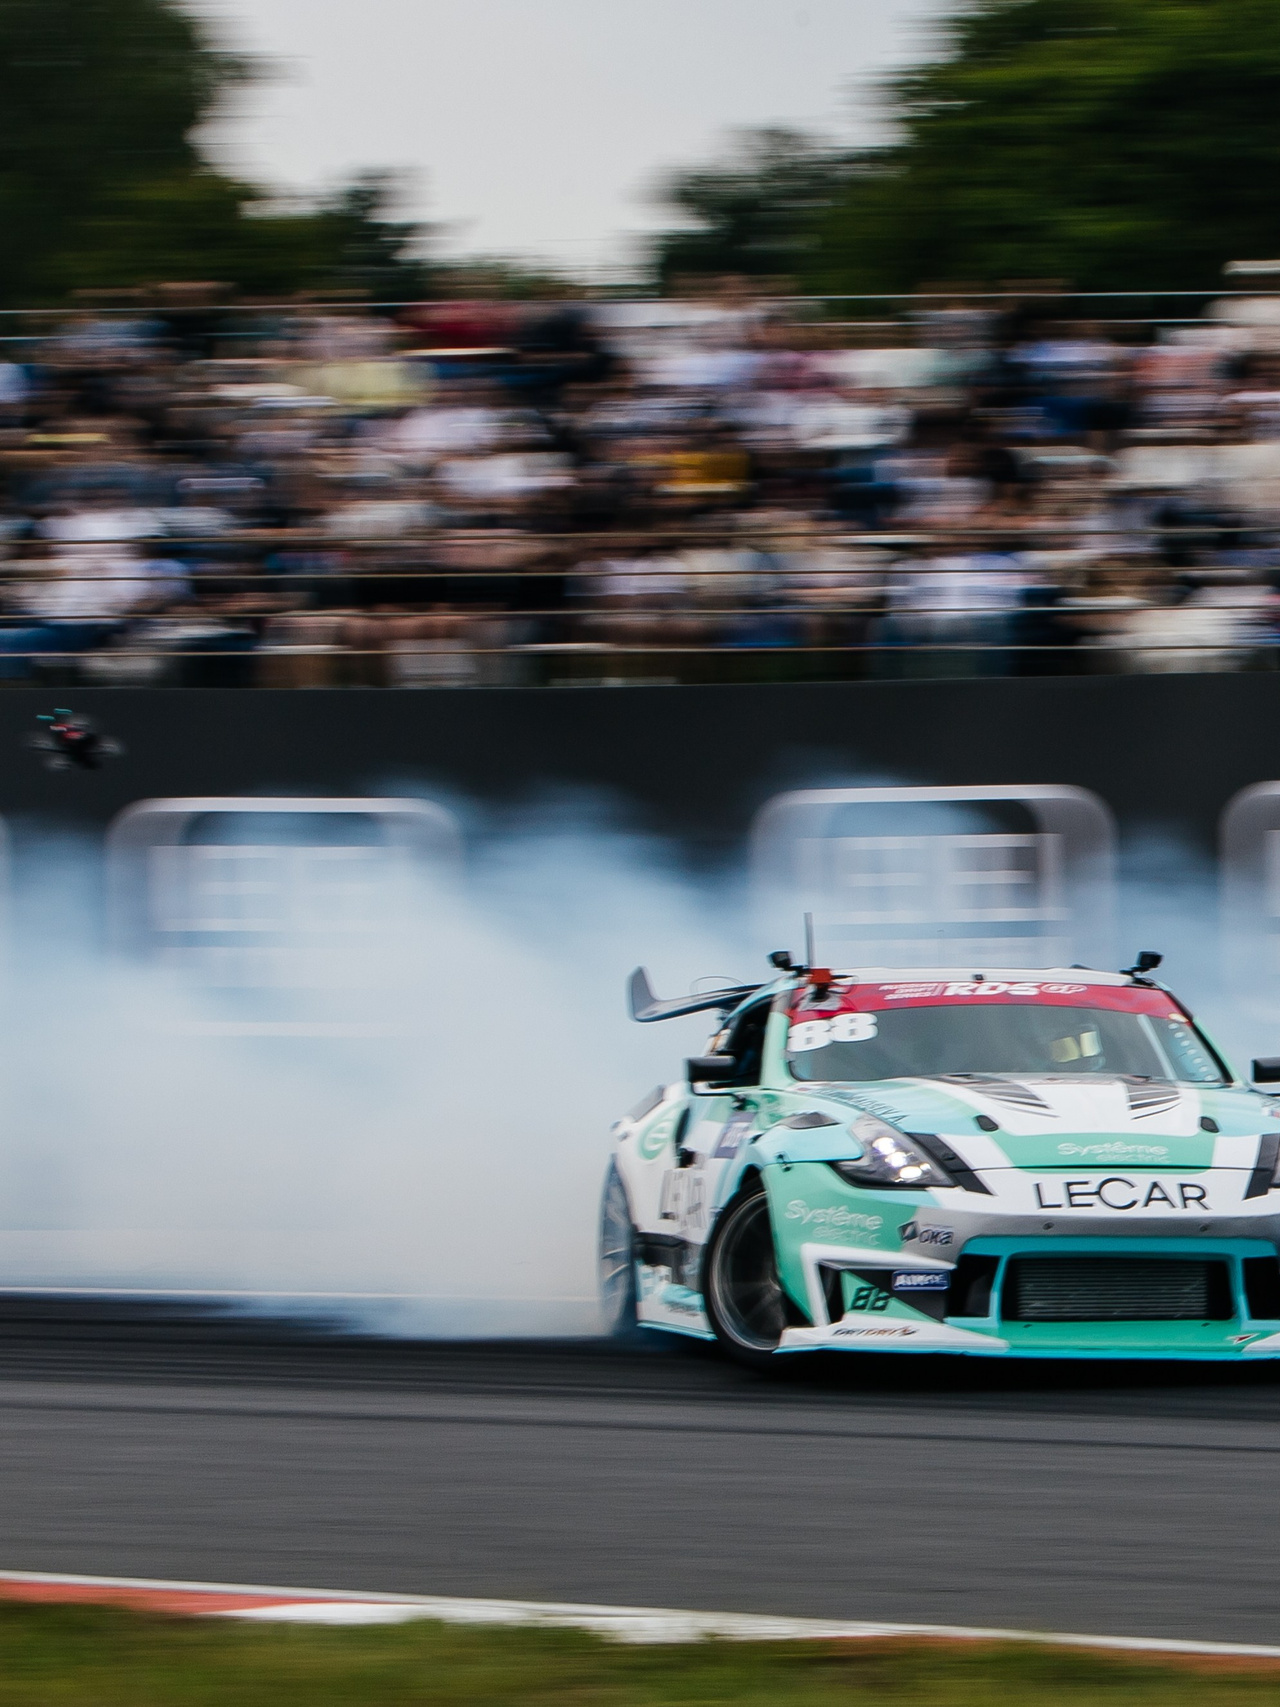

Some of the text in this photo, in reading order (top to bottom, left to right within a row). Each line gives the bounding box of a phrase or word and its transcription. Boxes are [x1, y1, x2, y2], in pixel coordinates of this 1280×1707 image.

[943, 982, 1041, 995] RDS
[787, 1013, 878, 1052] 88
[1032, 1176, 1212, 1211] LECAR
